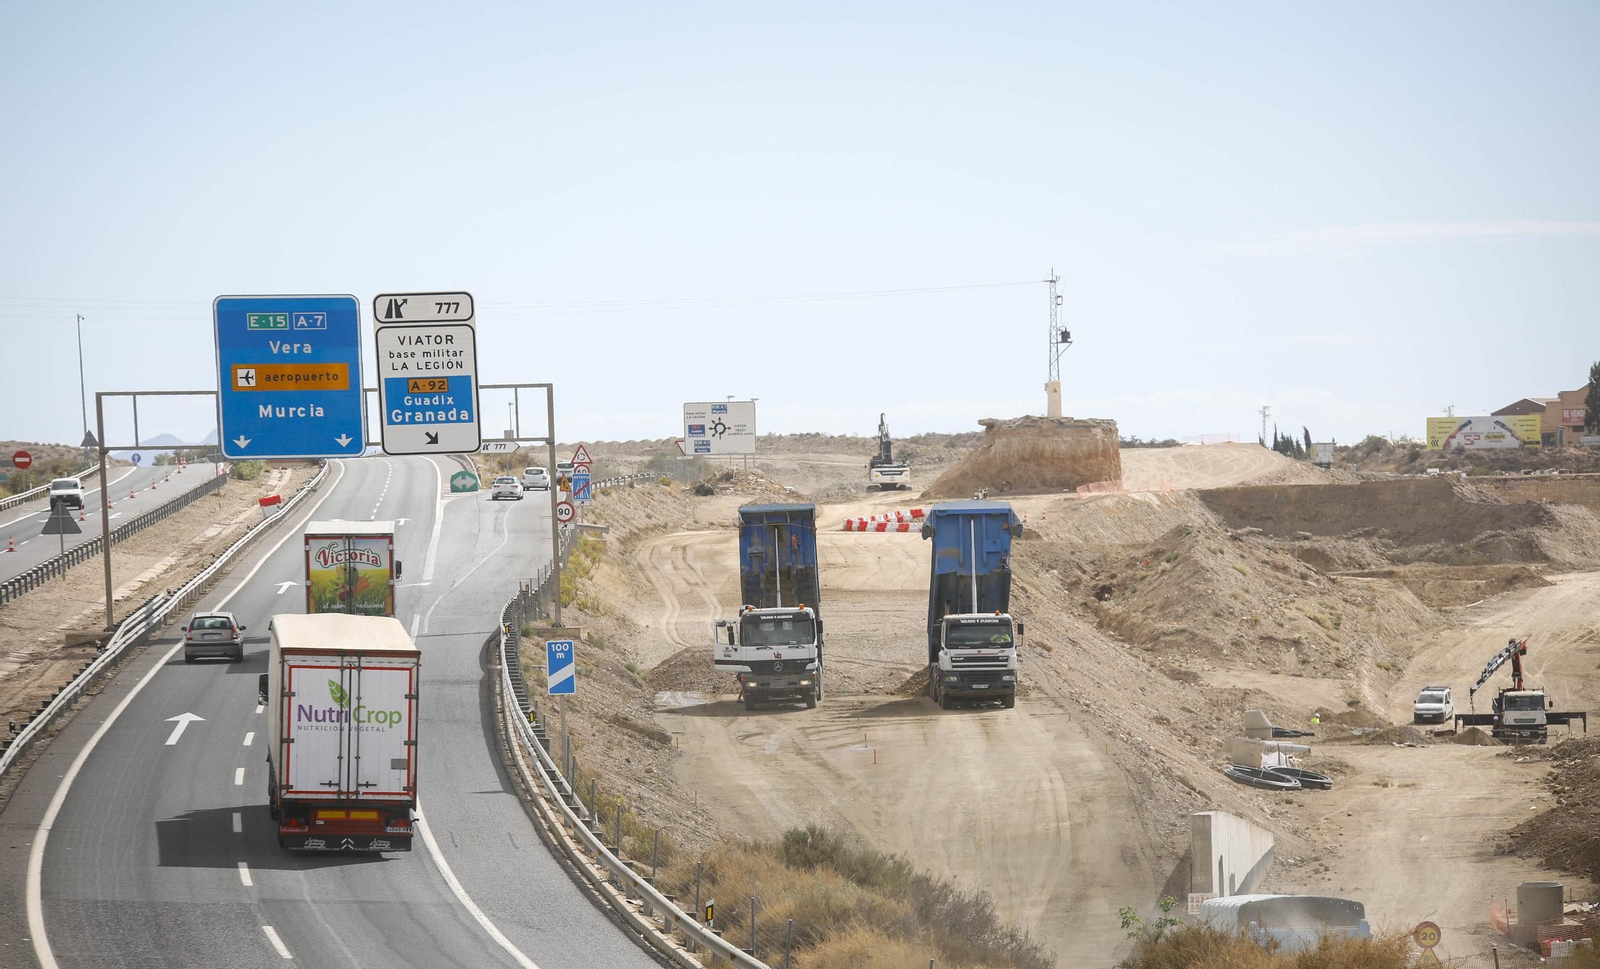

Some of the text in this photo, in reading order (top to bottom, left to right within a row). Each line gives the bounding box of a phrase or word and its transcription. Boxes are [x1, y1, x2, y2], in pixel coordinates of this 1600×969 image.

[435, 302, 460, 314] 777
[250, 316, 286, 327] E-15
[297, 315, 323, 327] A-7
[397, 334, 454, 346] VIATOR
[269, 340, 312, 354] Vera
[389, 348, 464, 359] base militar
[391, 358, 463, 372] LA LEGIÓN
[265, 371, 339, 383] aeropuerto
[411, 380, 446, 391] A-92
[403, 395, 454, 406] Guadix
[259, 404, 324, 418] Murcia
[391, 407, 469, 422] Granada
[1563, 409, 1585, 418] SE VEND
[316, 542, 381, 567] Victoria
[551, 643, 569, 652] 100
[1421, 932, 1436, 941] 20
